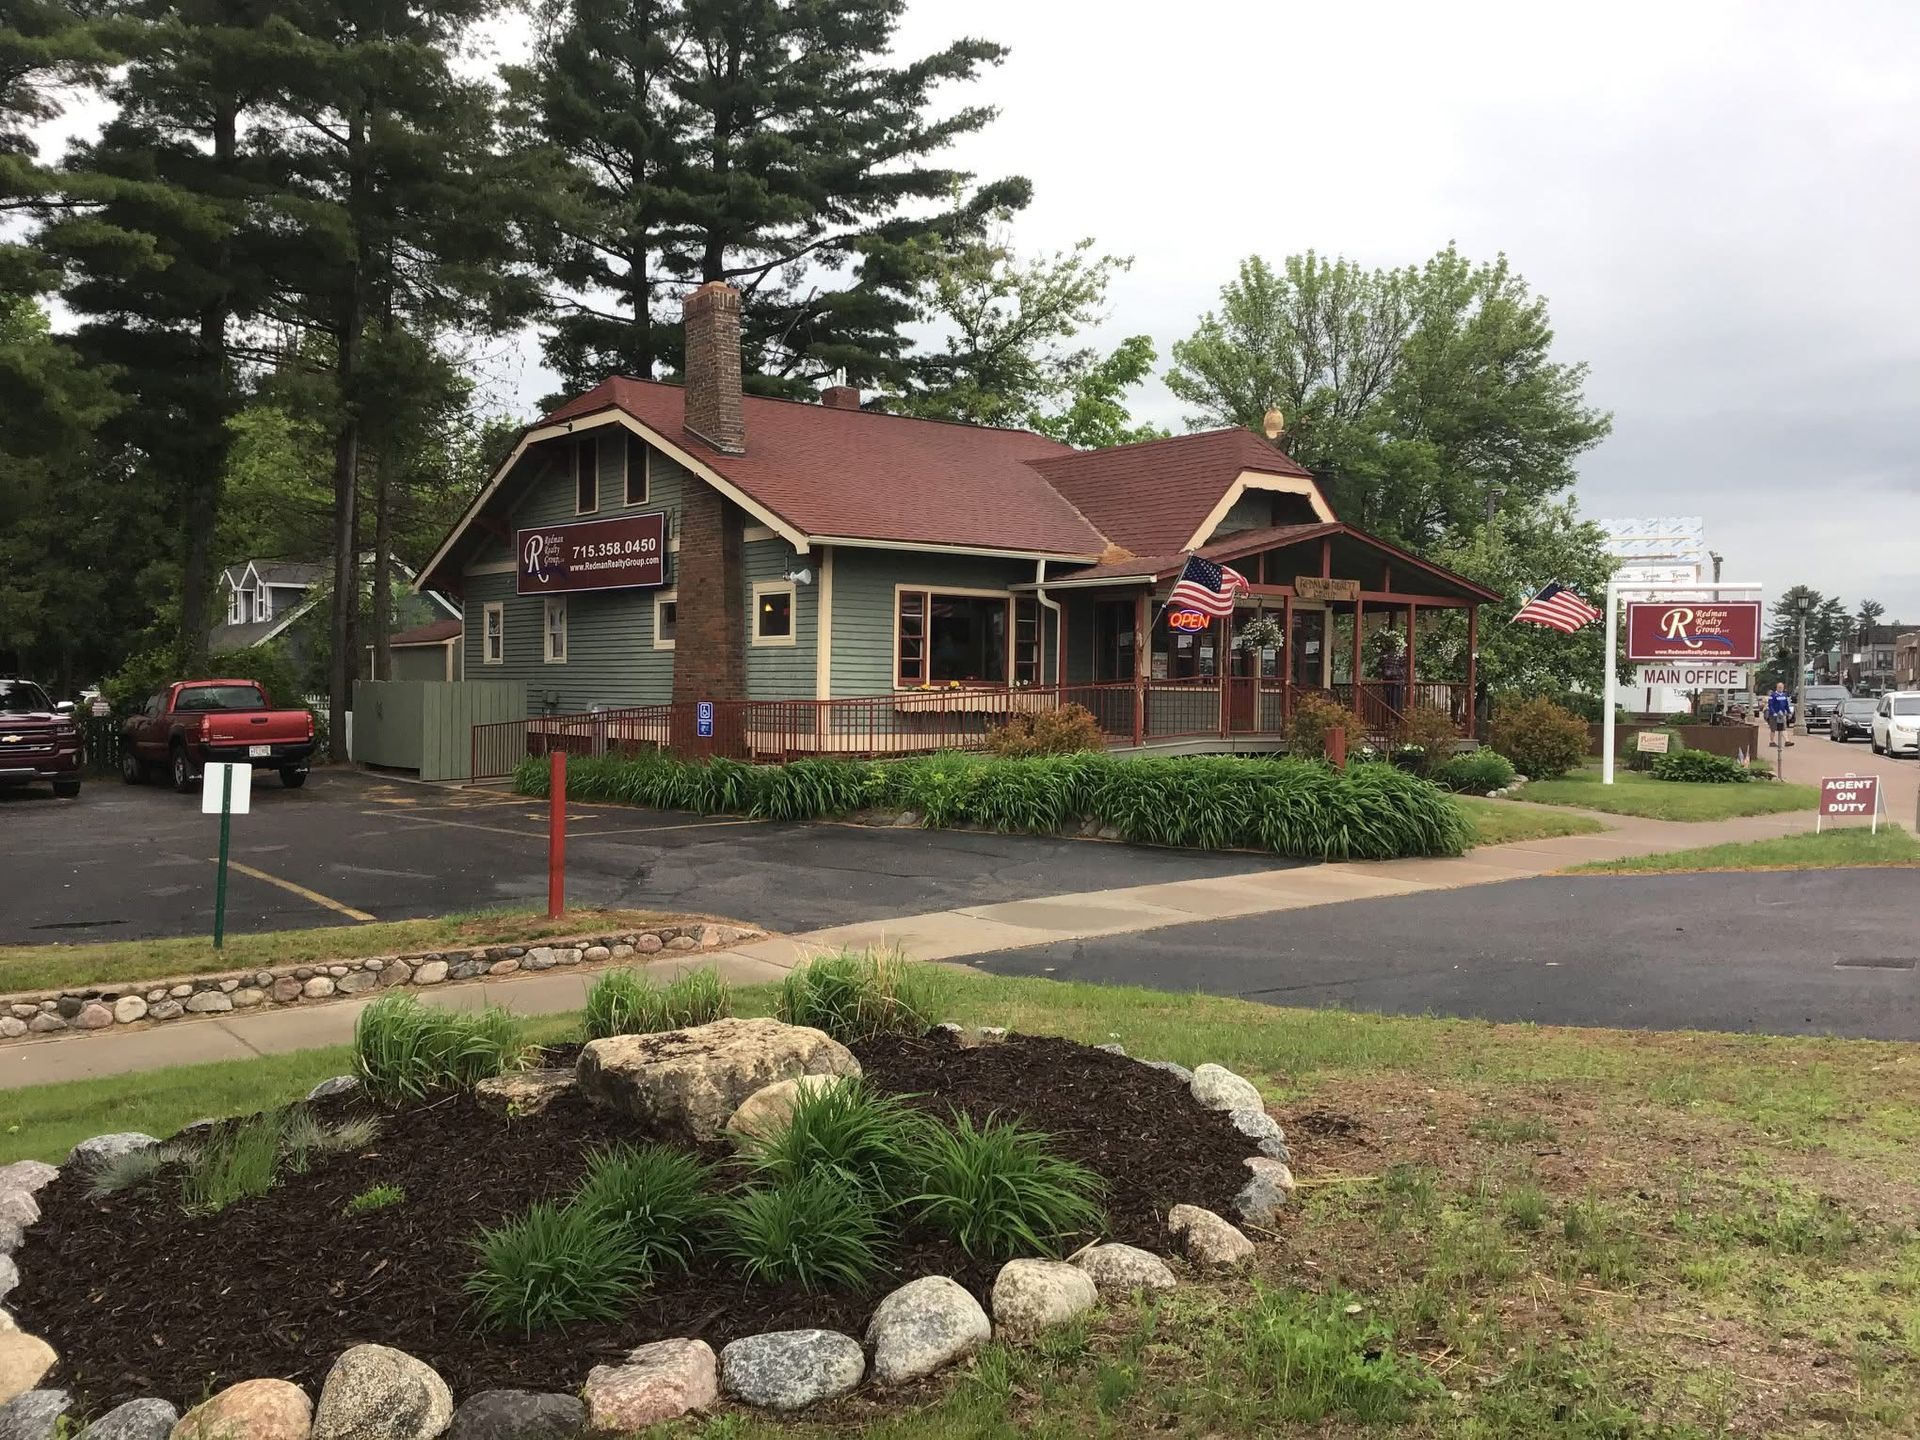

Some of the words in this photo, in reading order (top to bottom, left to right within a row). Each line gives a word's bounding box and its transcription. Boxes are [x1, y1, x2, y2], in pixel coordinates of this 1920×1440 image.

[572, 537, 656, 559] 715.358.0450
[524, 534, 549, 583] R
[569, 557, 660, 572] www.RedmanRealtyGroup.com
[1170, 612, 1210, 628] OPEN
[1695, 609, 1728, 618] Redman
[1661, 607, 1703, 648] R
[1695, 617, 1722, 627] Realty
[1644, 669, 1680, 684] MAIN
[1685, 670, 1738, 684] OFFICE
[1826, 780, 1873, 790] AGENT
[1836, 792, 1857, 801] ON
[1828, 803, 1867, 812] DUTY
